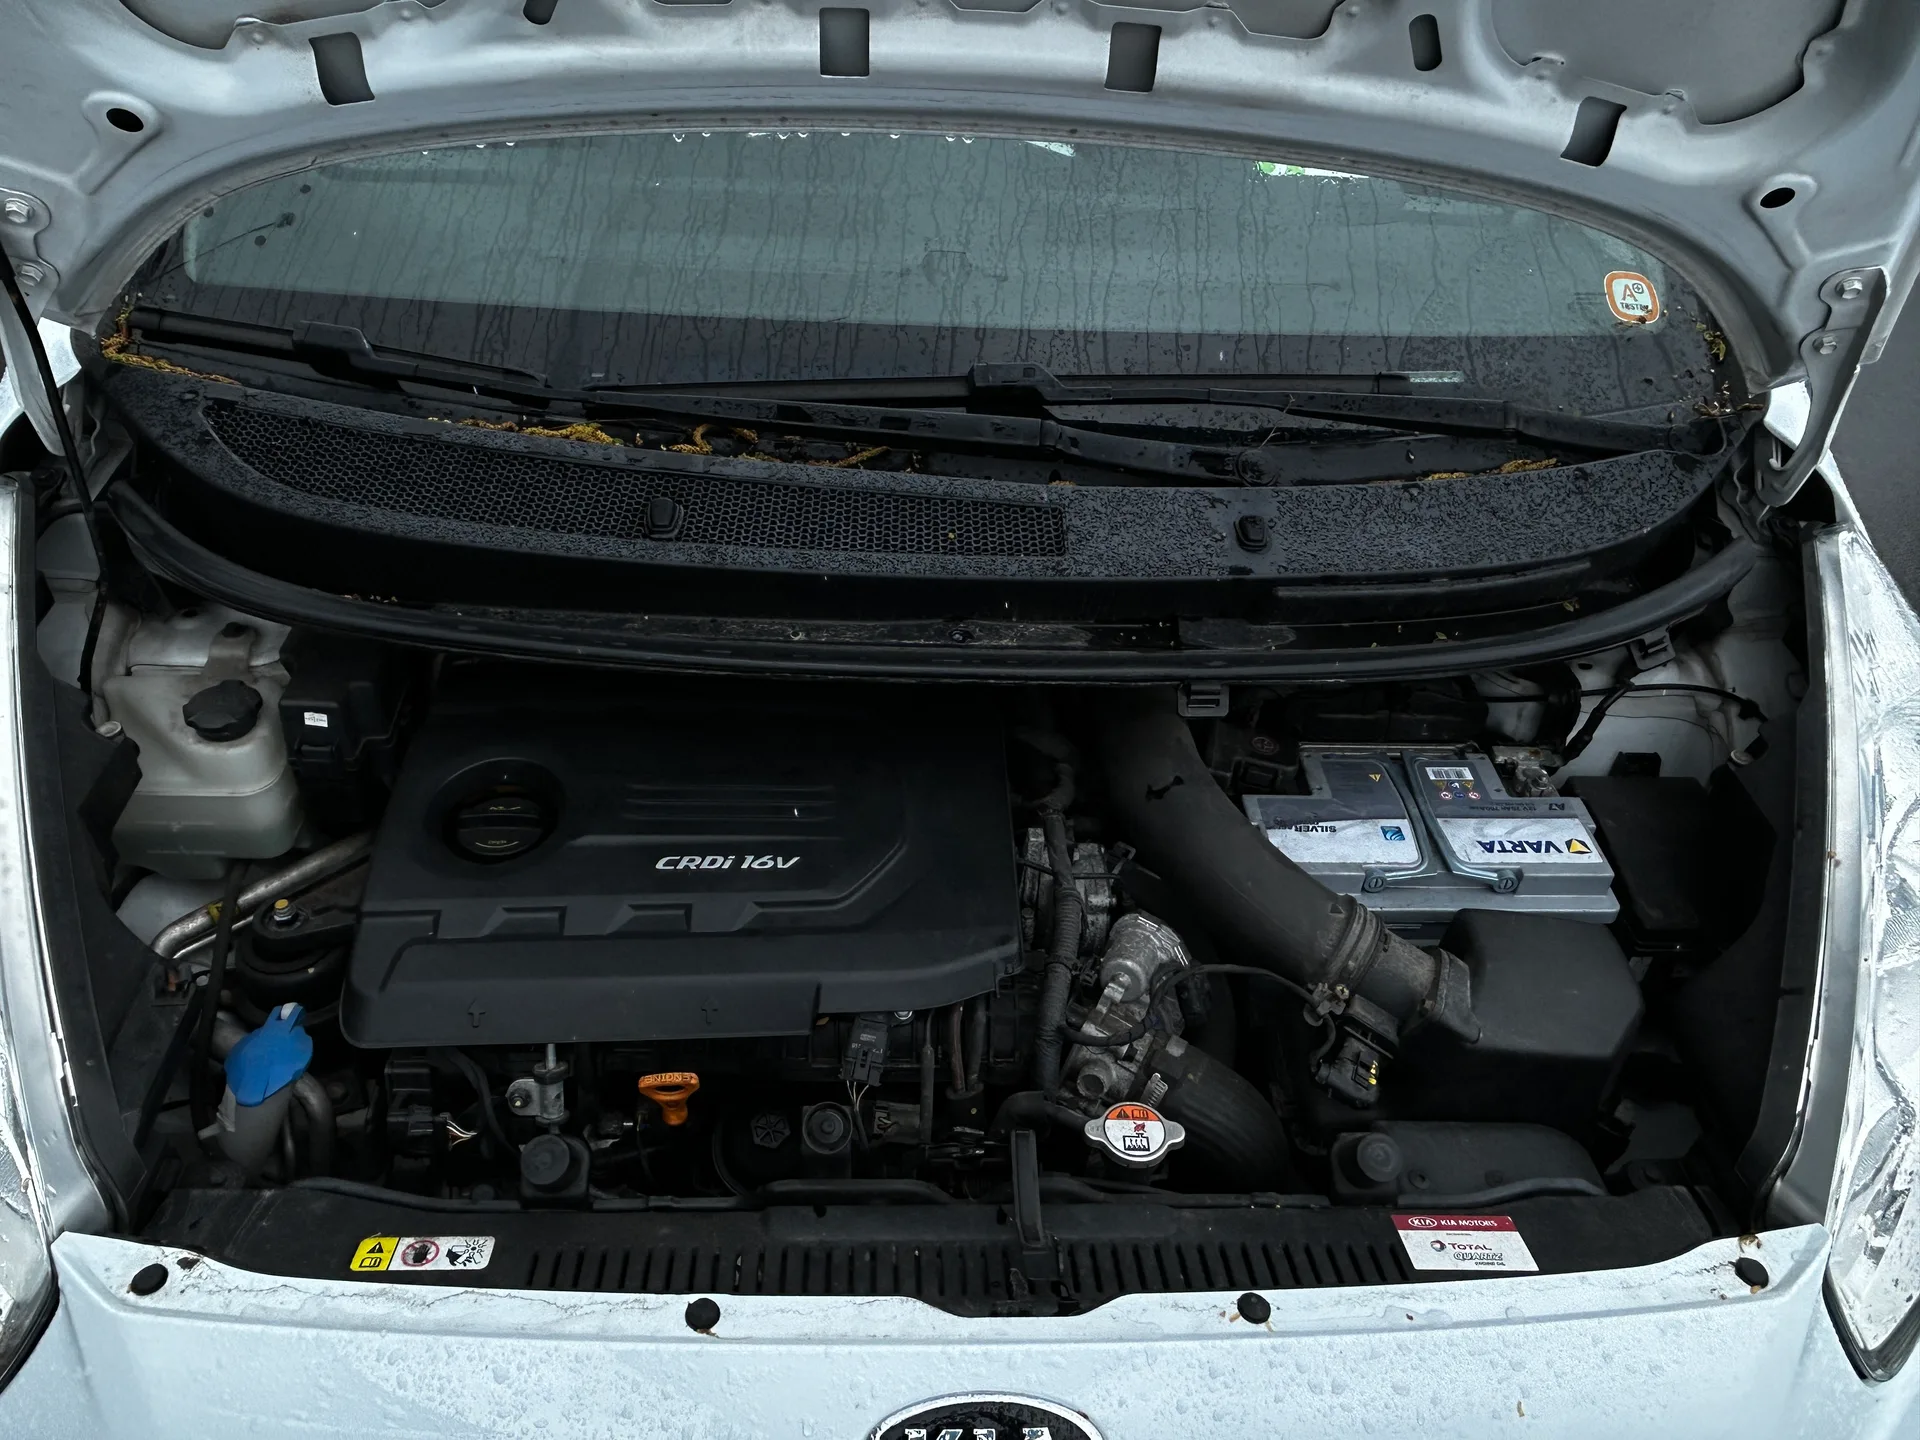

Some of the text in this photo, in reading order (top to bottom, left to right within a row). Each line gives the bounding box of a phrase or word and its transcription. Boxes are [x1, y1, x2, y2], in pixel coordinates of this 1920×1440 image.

[1293, 825, 1337, 833] SILVER
[1476, 840, 1564, 854] VARTA
[655, 855, 801, 870] CRDi 16V
[1411, 1218, 1434, 1226] KIA
[1458, 1219, 1498, 1227] MOTORS
[1448, 1242, 1493, 1251] TOTAL
[1453, 1251, 1504, 1261] QUARTZ
